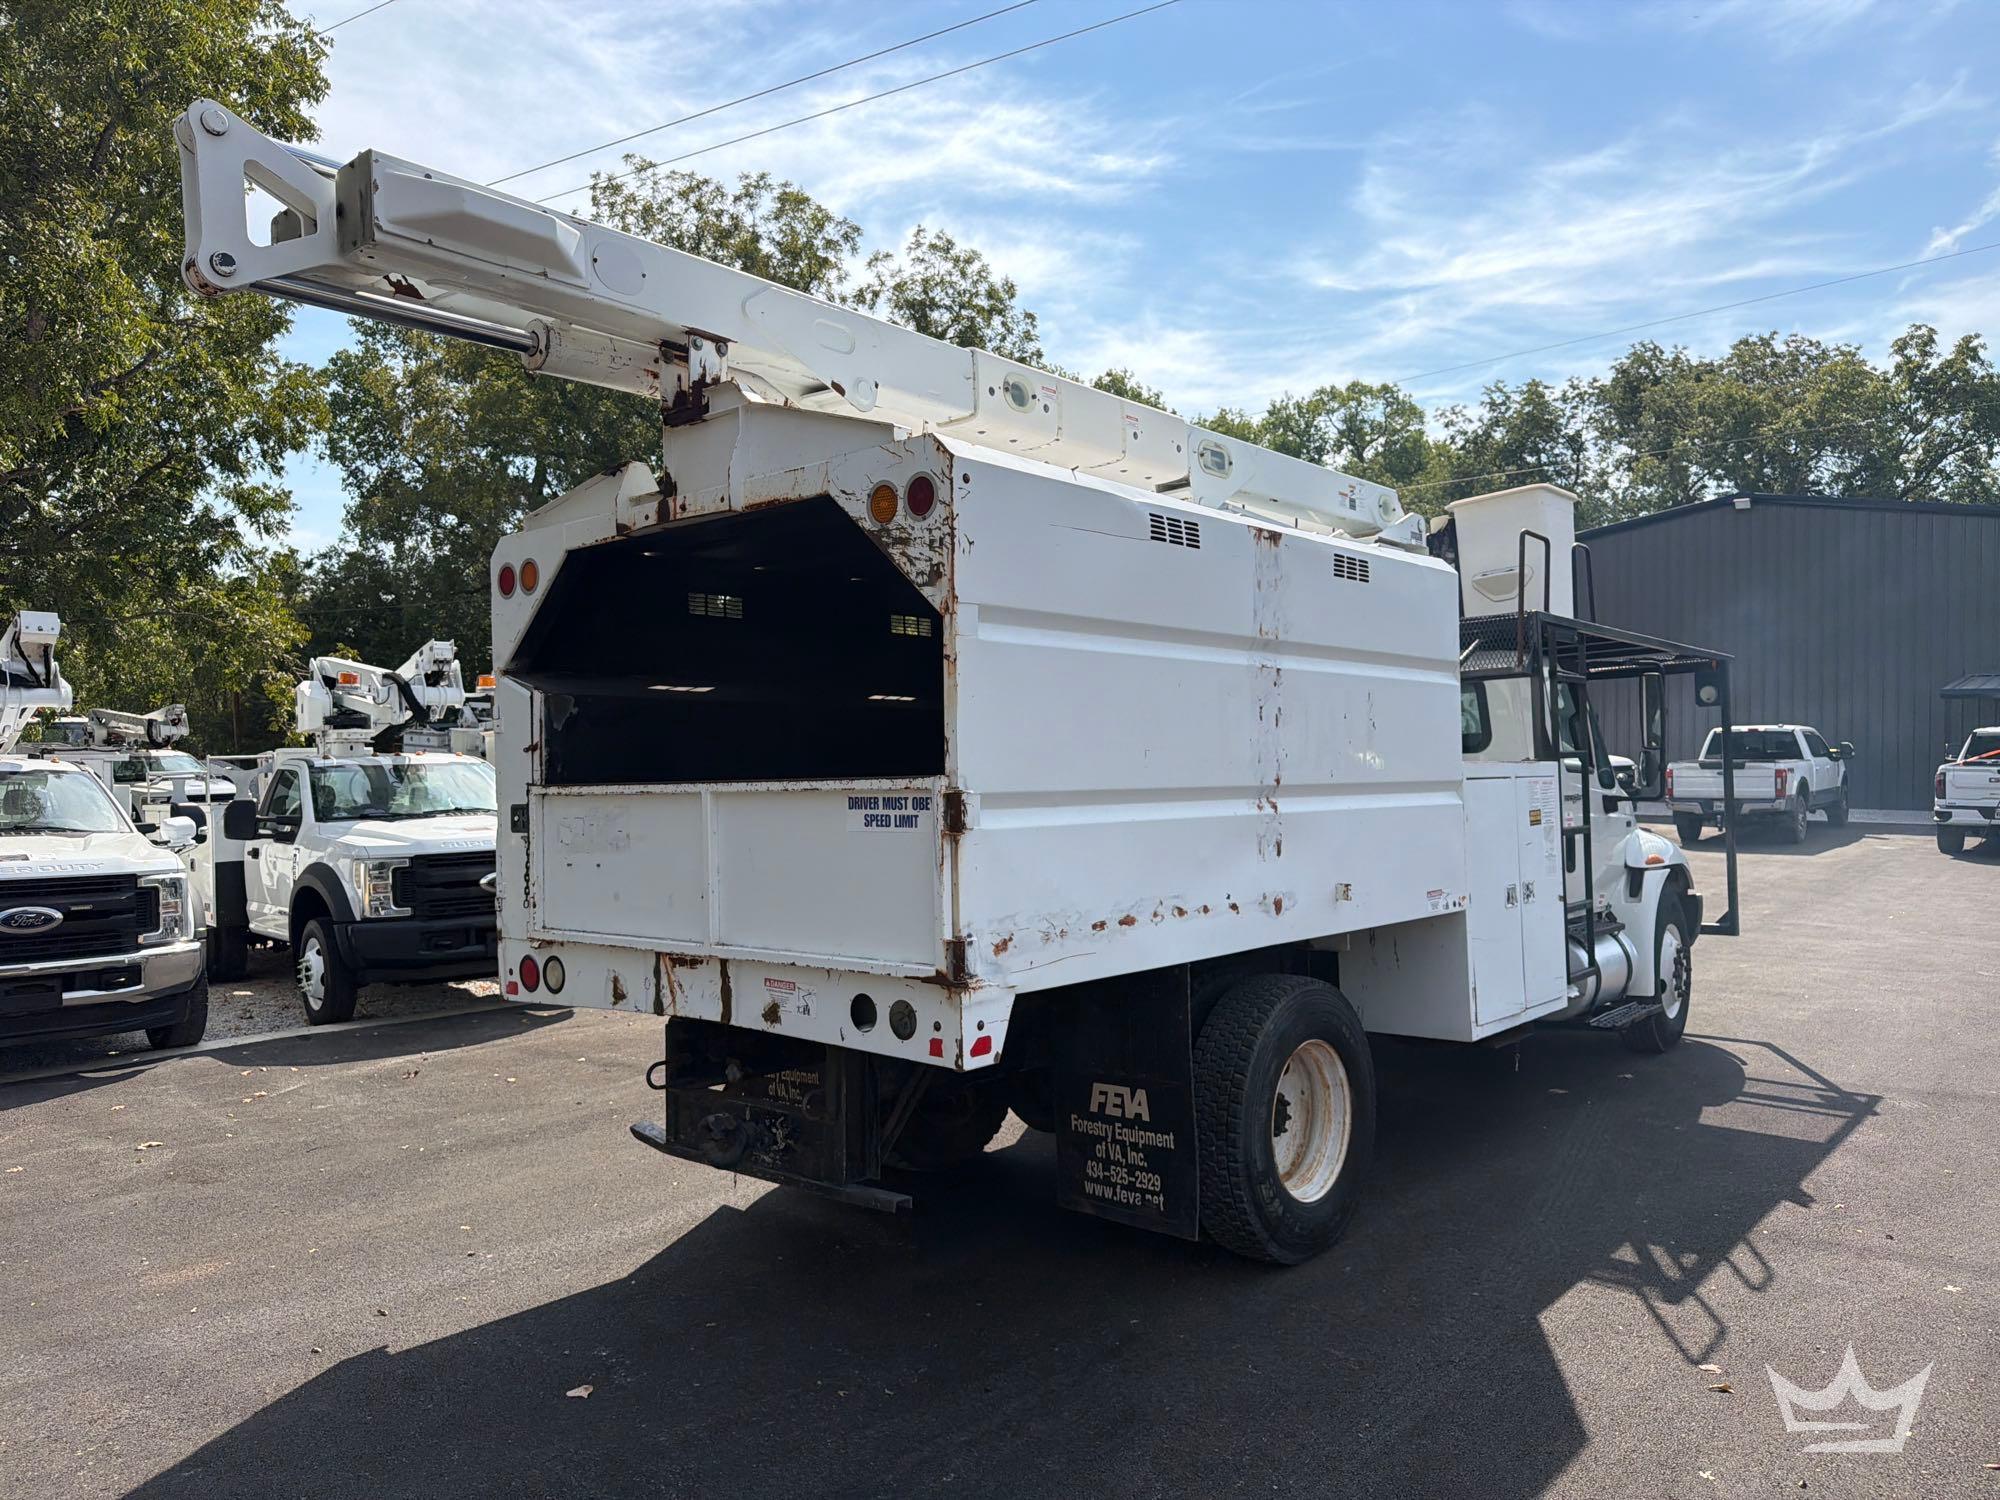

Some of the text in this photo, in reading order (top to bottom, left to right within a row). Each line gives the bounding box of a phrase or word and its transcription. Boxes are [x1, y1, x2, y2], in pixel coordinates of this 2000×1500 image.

[848, 796, 880, 811] DRIVER
[882, 796, 909, 811] MUST
[864, 813, 920, 828] SPEED LIMIT
[38, 862, 105, 873] DUTY
[11, 913, 45, 927] Ford
[770, 980, 796, 990] DANGER
[768, 1081, 776, 1096] of
[1089, 1082, 1151, 1122] FEVA
[1071, 1113, 1175, 1150] Forestry Equipment
[1095, 1142, 1148, 1168] of VA, Inc.
[1086, 1160, 1161, 1192] 434-525-2929
[1084, 1180, 1165, 1212] www.fevanet
